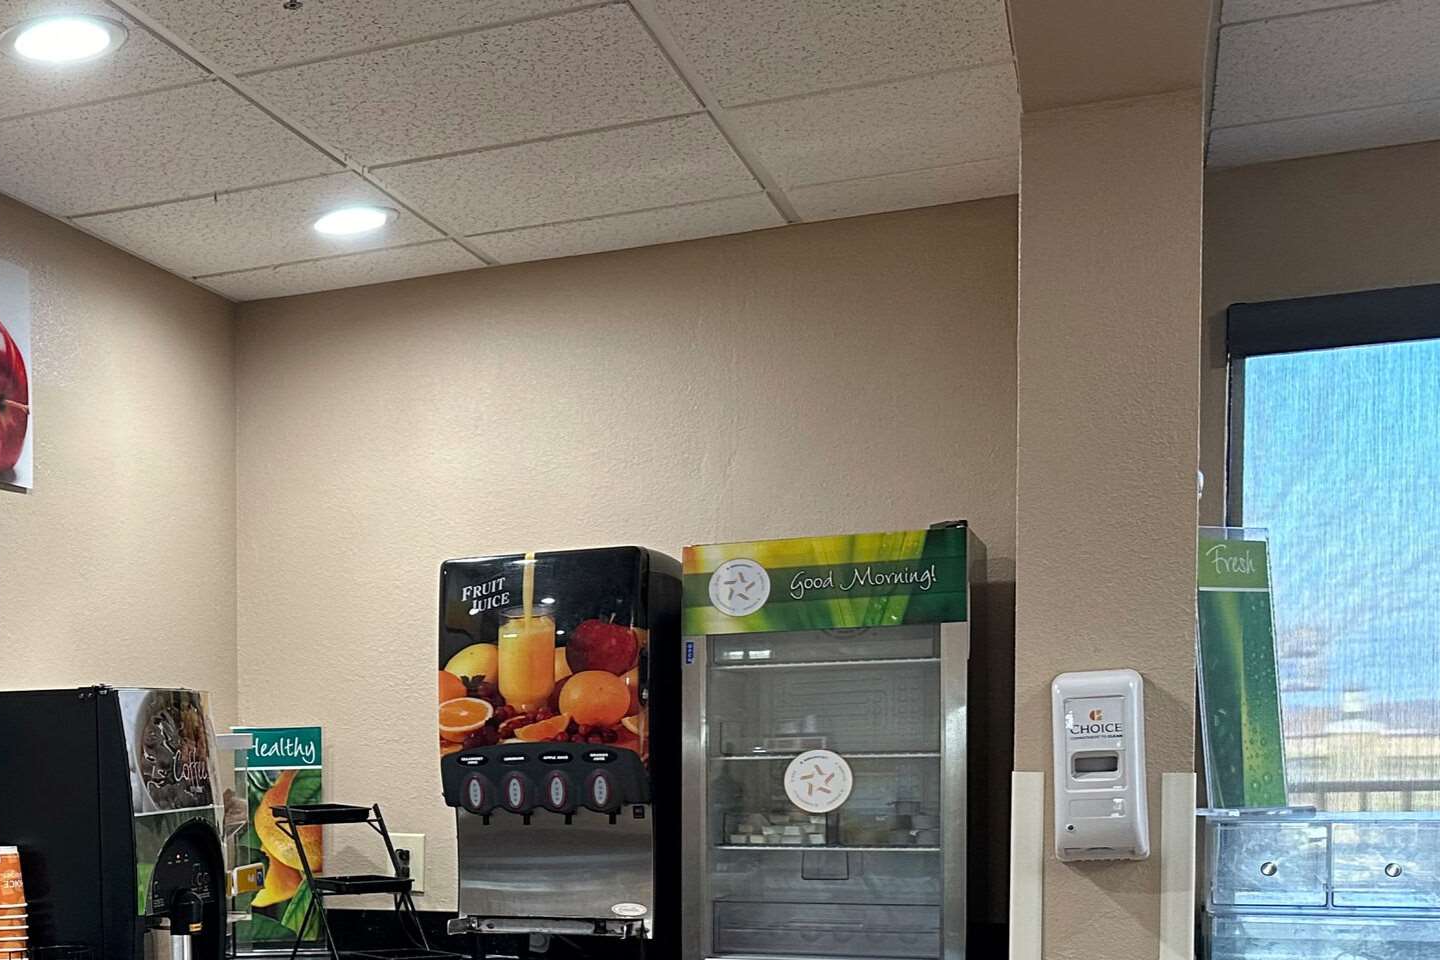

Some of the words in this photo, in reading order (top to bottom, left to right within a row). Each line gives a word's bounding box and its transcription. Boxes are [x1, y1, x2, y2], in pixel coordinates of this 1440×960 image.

[1205, 544, 1256, 575] Fresh
[461, 577, 506, 602] FRUIT
[790, 570, 833, 600] Good
[839, 564, 937, 591] Morning!
[470, 592, 510, 612] JUICE
[1070, 722, 1123, 735] CHOICE
